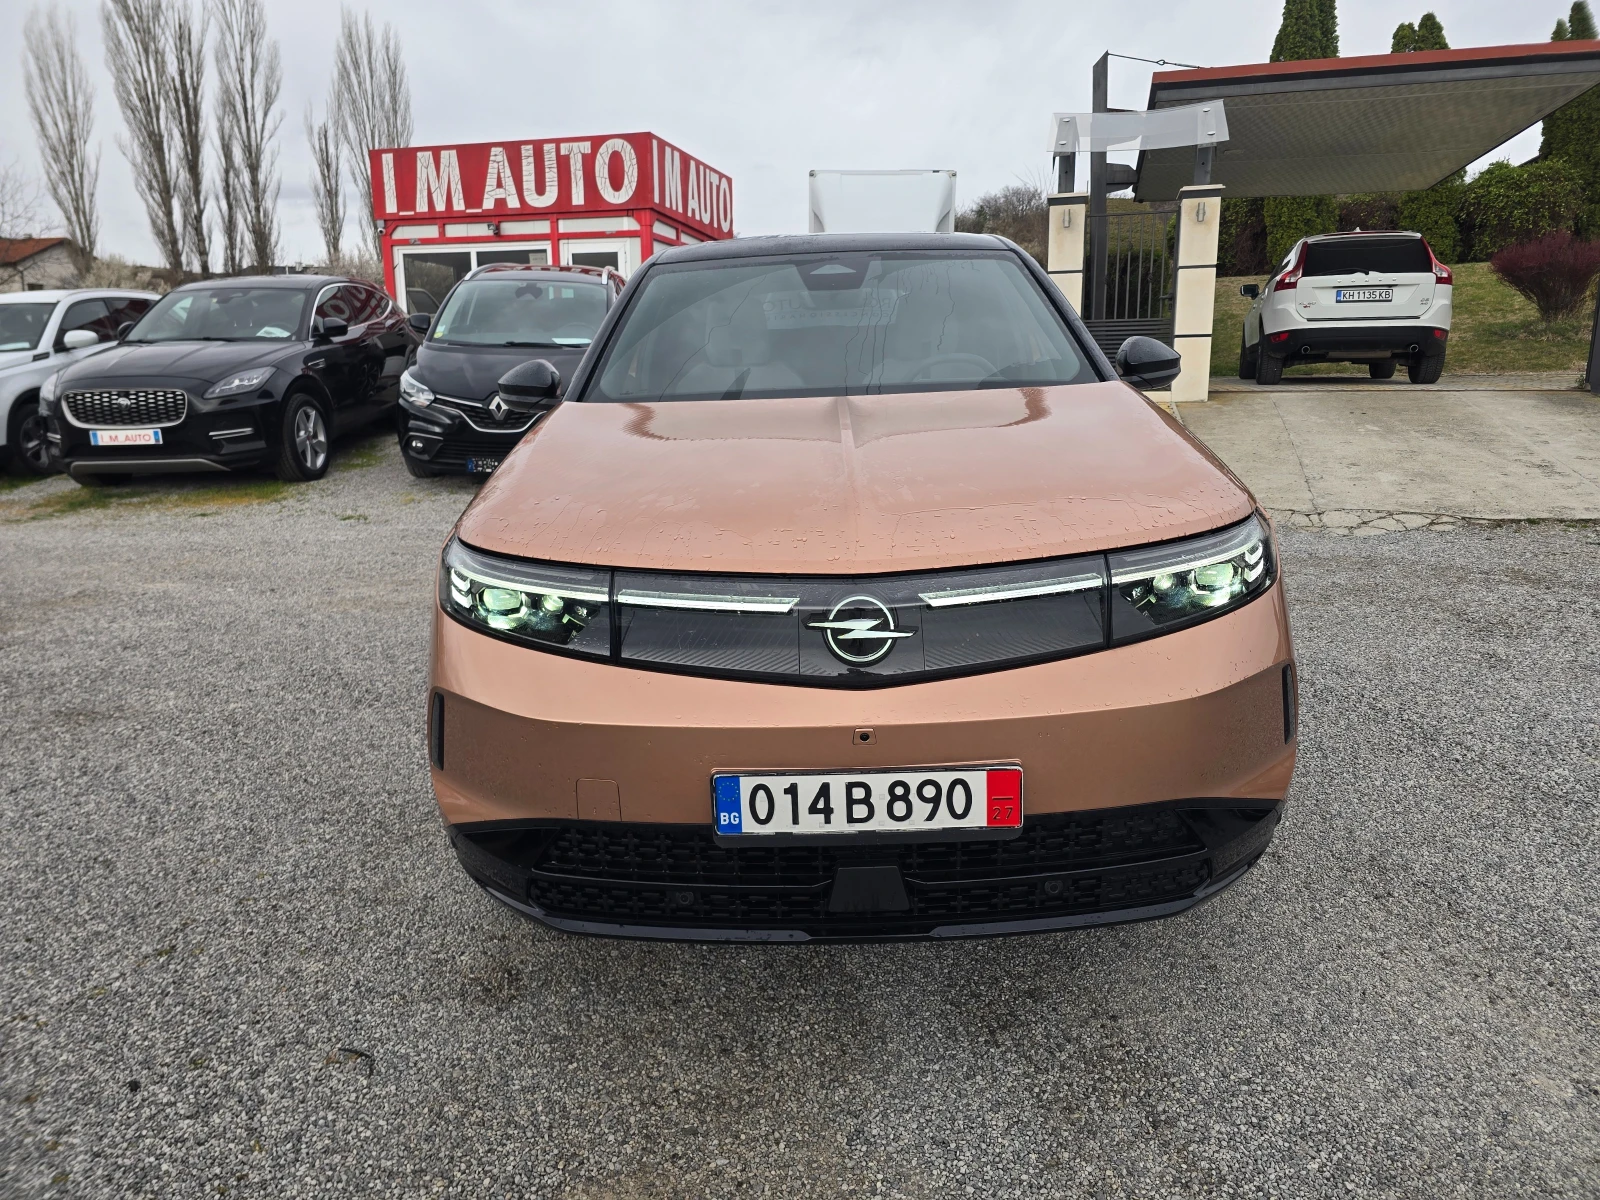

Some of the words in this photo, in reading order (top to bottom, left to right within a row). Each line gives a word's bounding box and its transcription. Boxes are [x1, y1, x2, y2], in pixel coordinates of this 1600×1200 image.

[652, 138, 660, 205] I
[664, 145, 683, 214] M
[687, 159, 732, 233] AUTO
[1342, 291, 1355, 300] KH
[1357, 290, 1377, 300] 1135
[1378, 289, 1391, 299] KB
[720, 812, 740, 825] BG
[992, 806, 1014, 820] 27
